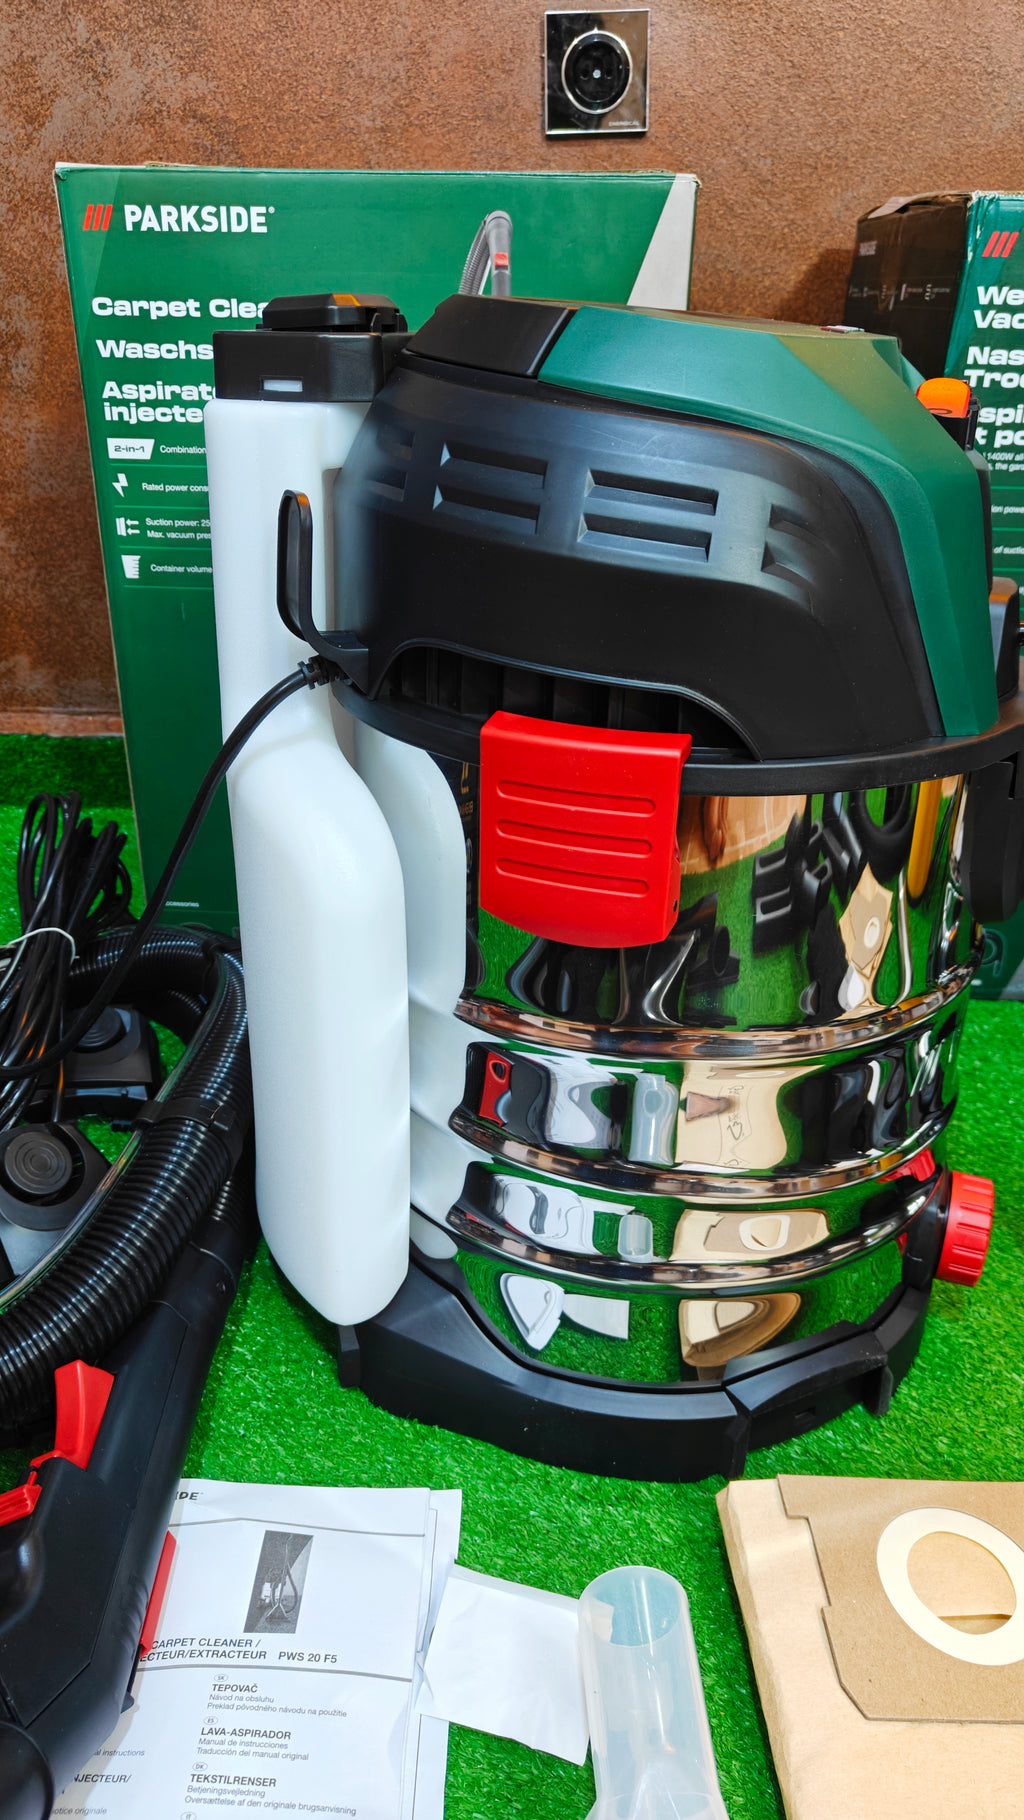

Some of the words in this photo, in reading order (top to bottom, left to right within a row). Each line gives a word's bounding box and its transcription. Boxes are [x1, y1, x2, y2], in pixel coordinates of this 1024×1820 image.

[92, 297, 201, 319] Carpet
[95, 339, 214, 360] Waschs
[102, 381, 216, 402] Aspirat
[103, 402, 204, 425] injecte
[114, 445, 145, 453] 2-in-1
[142, 482, 164, 491] Rated
[165, 484, 188, 493] power
[145, 517, 174, 527] Suction
[147, 530, 165, 538] Max.
[150, 563, 185, 573] Container
[151, 1638, 196, 1650] CARPET
[199, 1638, 253, 1648] CLEANER
[278, 1651, 305, 1662] PWS
[307, 1652, 321, 1663] 20
[324, 1653, 338, 1664] F5
[212, 1683, 258, 1693] TEPOVAČ
[245, 1695, 275, 1703] obsluhu
[207, 1702, 235, 1710] Preklad
[278, 1705, 306, 1715] návodu
[201, 1727, 292, 1740] LAVA-ASPIRADOR
[199, 1738, 226, 1746] Manual
[239, 1740, 289, 1750] instrucciones
[103, 1749, 145, 1757] instructions
[197, 1747, 237, 1756] Traducción
[239, 1748, 251, 1757] del
[252, 1751, 280, 1759] manual
[281, 1753, 309, 1762] original
[190, 1773, 277, 1788] TEKSTILRENSER
[187, 1784, 266, 1799] Betjeningsvejledning
[75, 1807, 108, 1817] originale
[237, 1798, 245, 1806] af
[246, 1799, 262, 1808] den
[263, 1801, 297, 1811] originale
[298, 1803, 357, 1817] brugsanvisning
